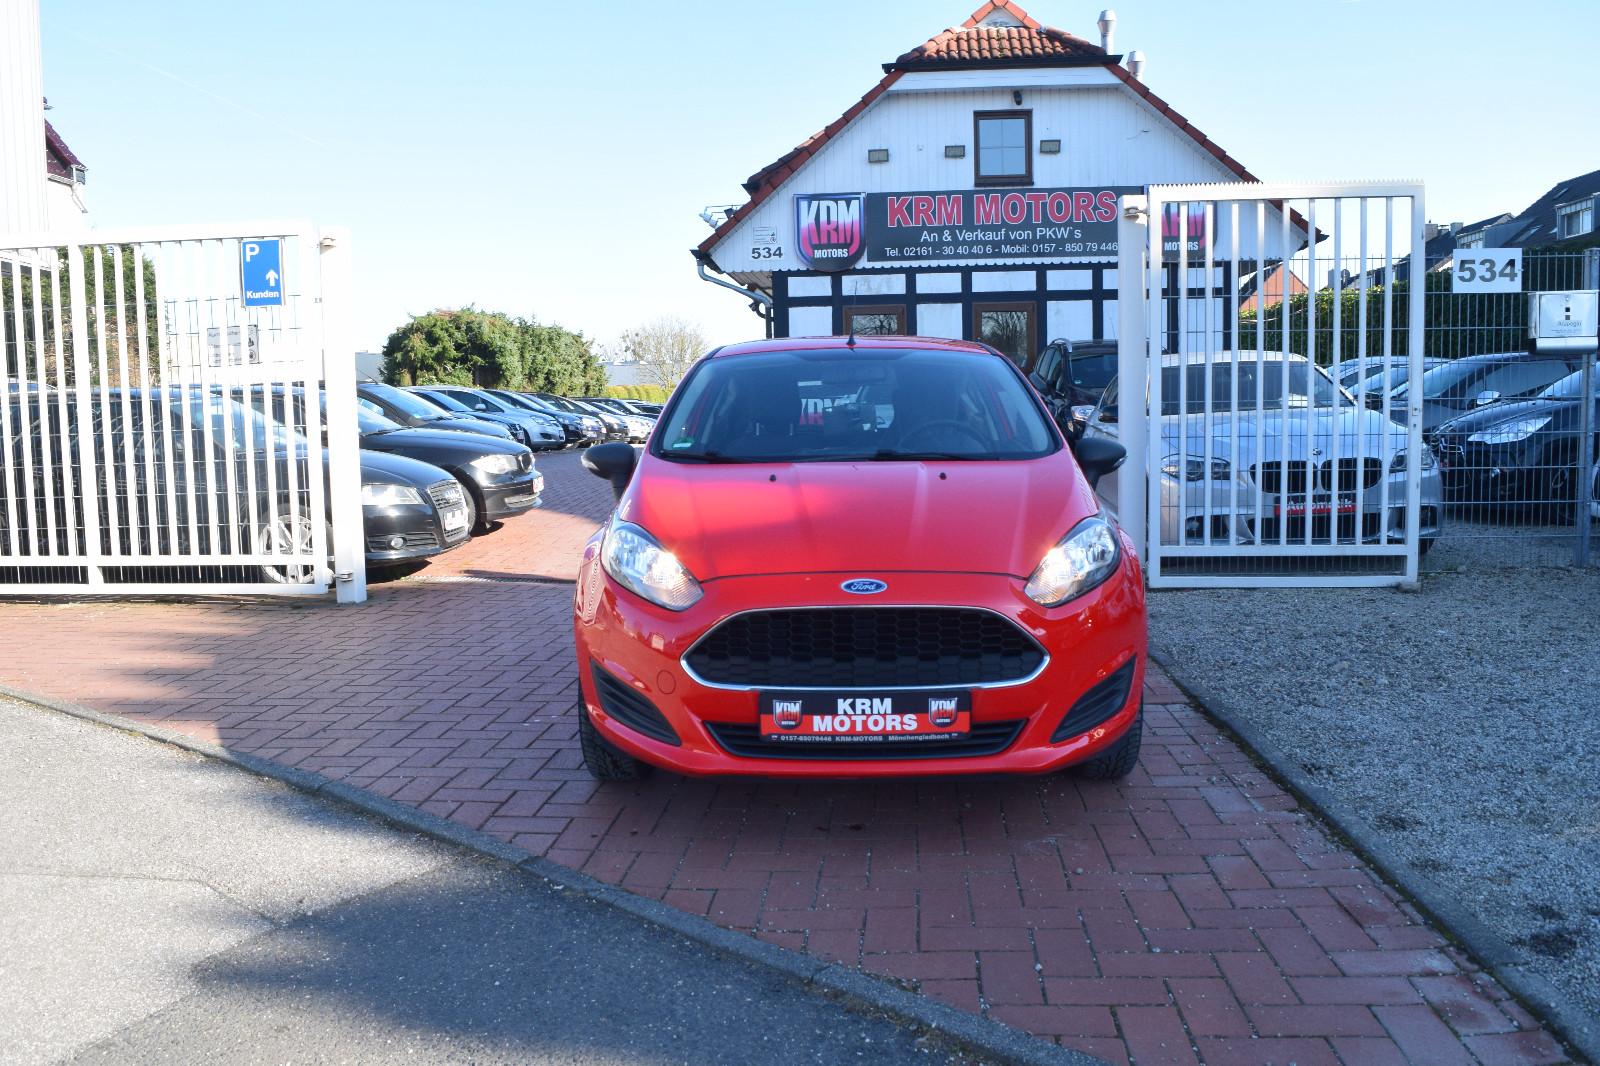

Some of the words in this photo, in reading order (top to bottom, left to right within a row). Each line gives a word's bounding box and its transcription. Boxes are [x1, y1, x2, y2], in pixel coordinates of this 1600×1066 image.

[887, 195, 963, 227] KRM
[974, 191, 1118, 226] MOTORS
[800, 199, 860, 250] KRM
[920, 230, 938, 243] An
[942, 230, 952, 241] &
[955, 229, 1006, 241] Verkauf
[1009, 230, 1032, 240] von
[245, 243, 260, 262] P
[751, 246, 783, 259] 534
[814, 248, 849, 259] MOTORS
[885, 246, 901, 257] Tel.
[903, 246, 933, 257] 02161
[942, 246, 955, 255] 30
[957, 245, 969, 255] 40
[971, 245, 983, 254] 40
[986, 245, 993, 254] 6
[1001, 244, 1030, 254] Mobil:
[1032, 243, 1056, 253] 0157
[1064, 243, 1083, 252] 850
[1085, 242, 1098, 252] 79
[1100, 242, 1118, 251] 446
[1457, 258, 1518, 283] 534
[246, 290, 279, 299] Kunden
[837, 697, 892, 715] KRM
[813, 714, 918, 732] MOTORS
[835, 735, 883, 743] KRM-MOTORS
[888, 733, 950, 742] Mönchengladbach
